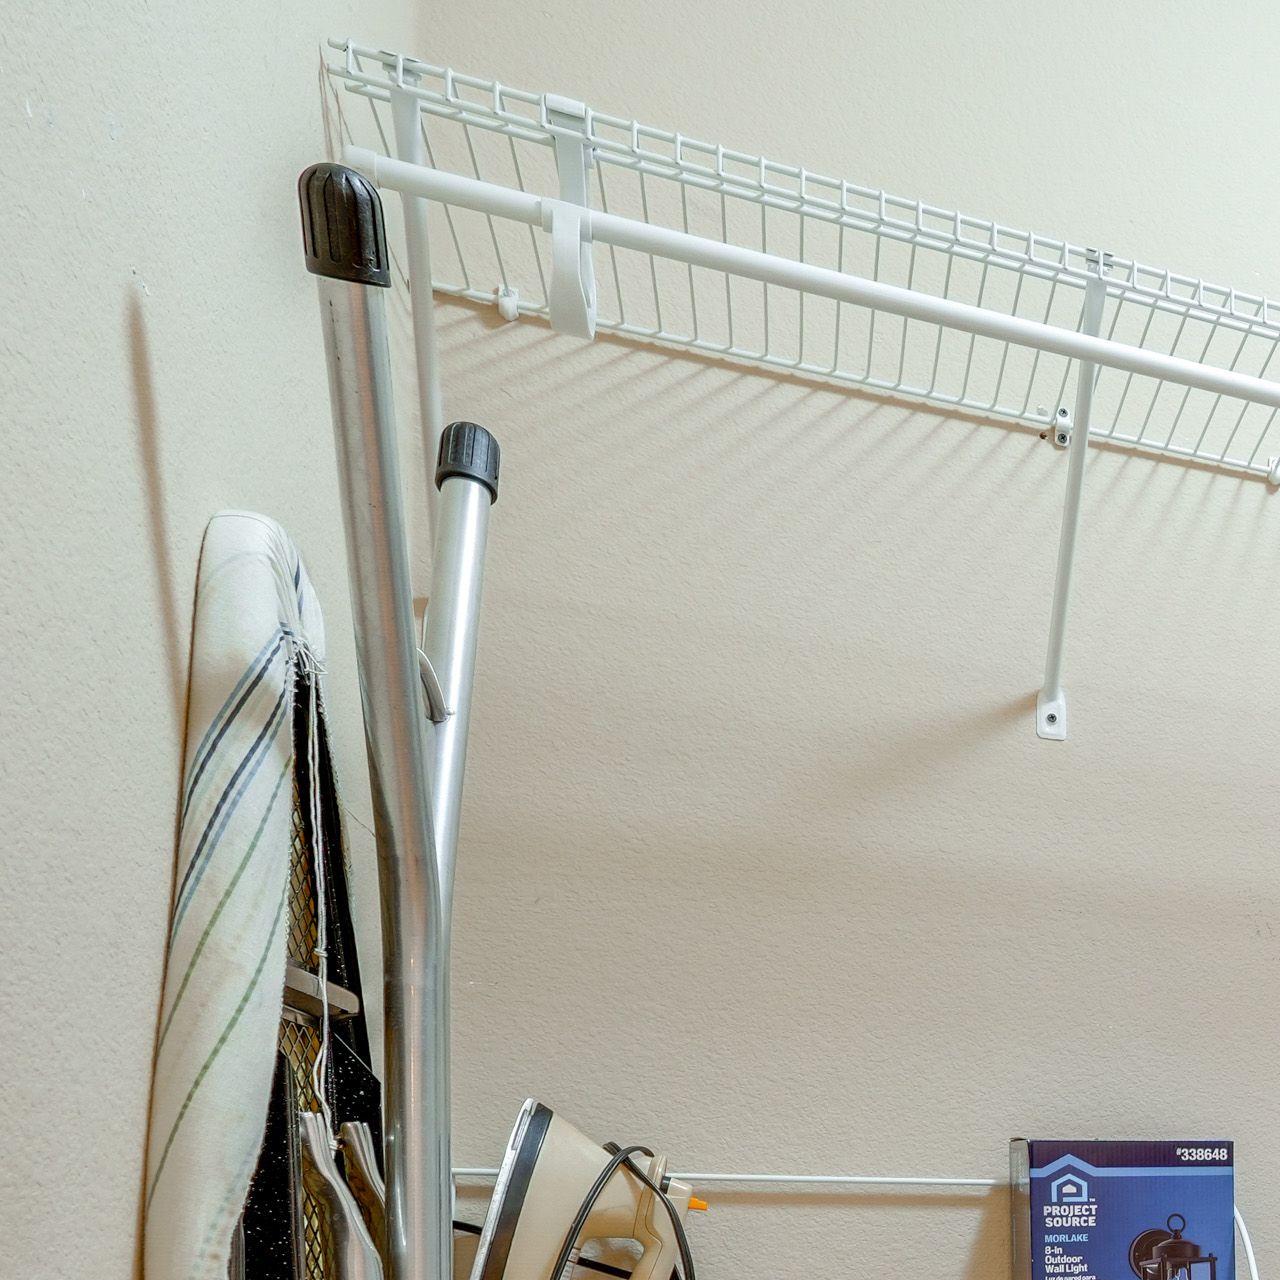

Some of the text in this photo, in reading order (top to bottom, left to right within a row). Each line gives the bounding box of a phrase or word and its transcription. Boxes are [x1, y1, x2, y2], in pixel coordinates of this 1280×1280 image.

[1176, 1147, 1228, 1161] #338648
[1043, 1204, 1098, 1216] PROJECT
[1045, 1216, 1096, 1227] SOURCE
[1044, 1233, 1088, 1243] MORLAKE
[1044, 1246, 1063, 1255] 8-in
[1044, 1255, 1083, 1264] Outdoor
[1044, 1264, 1088, 1274] Wall Light
